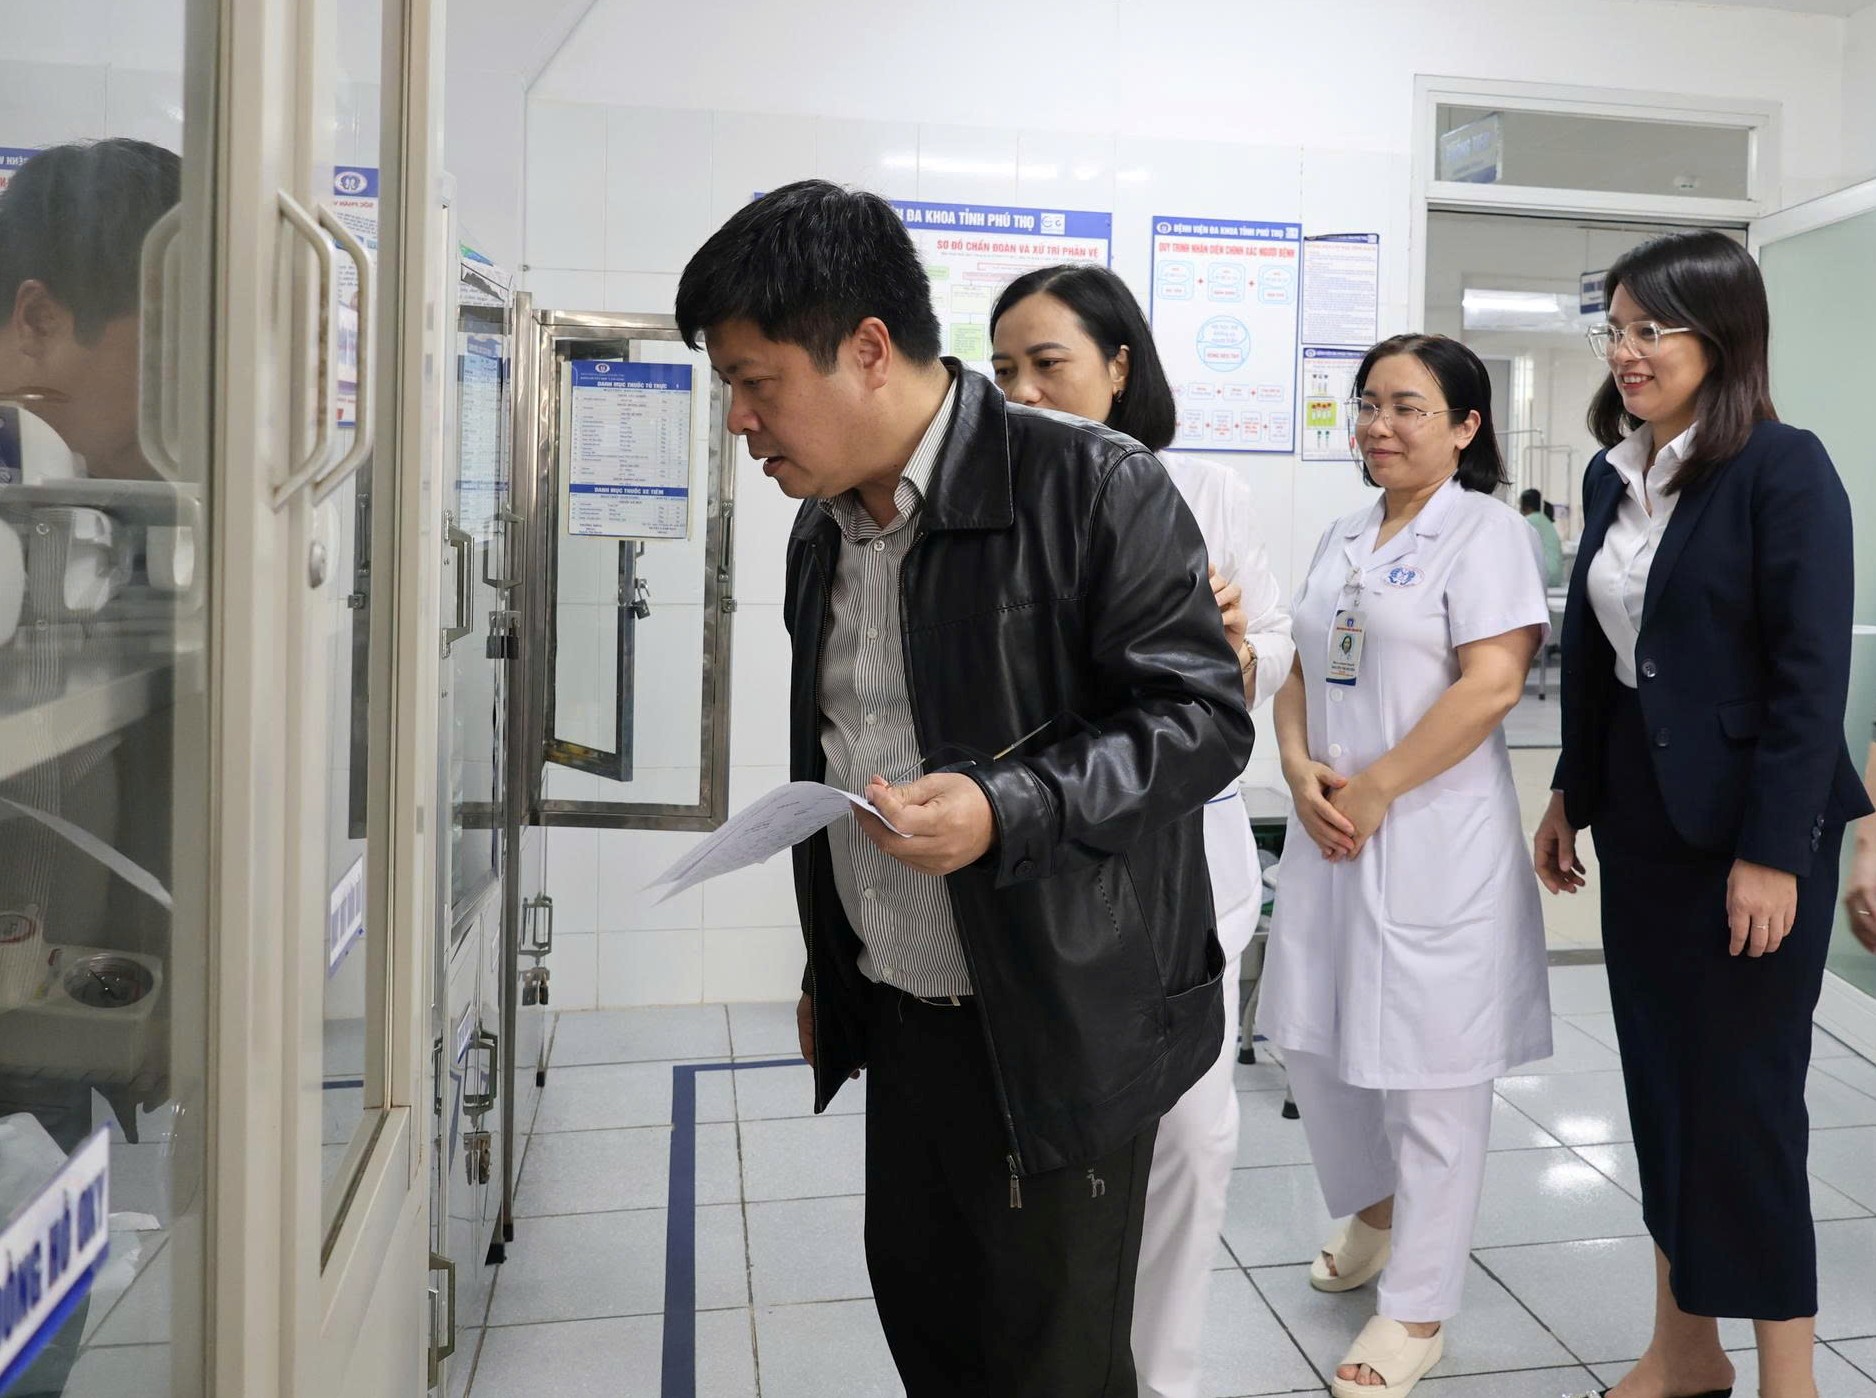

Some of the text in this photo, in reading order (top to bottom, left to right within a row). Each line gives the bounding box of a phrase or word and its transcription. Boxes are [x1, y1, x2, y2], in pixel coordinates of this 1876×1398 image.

[906, 208, 923, 223] ĐA
[925, 210, 956, 224] KHOA
[958, 207, 985, 226] TỈNH
[987, 211, 1010, 227] PHÚ
[1013, 214, 1035, 231] THỌ
[1220, 226, 1239, 236] KHOA
